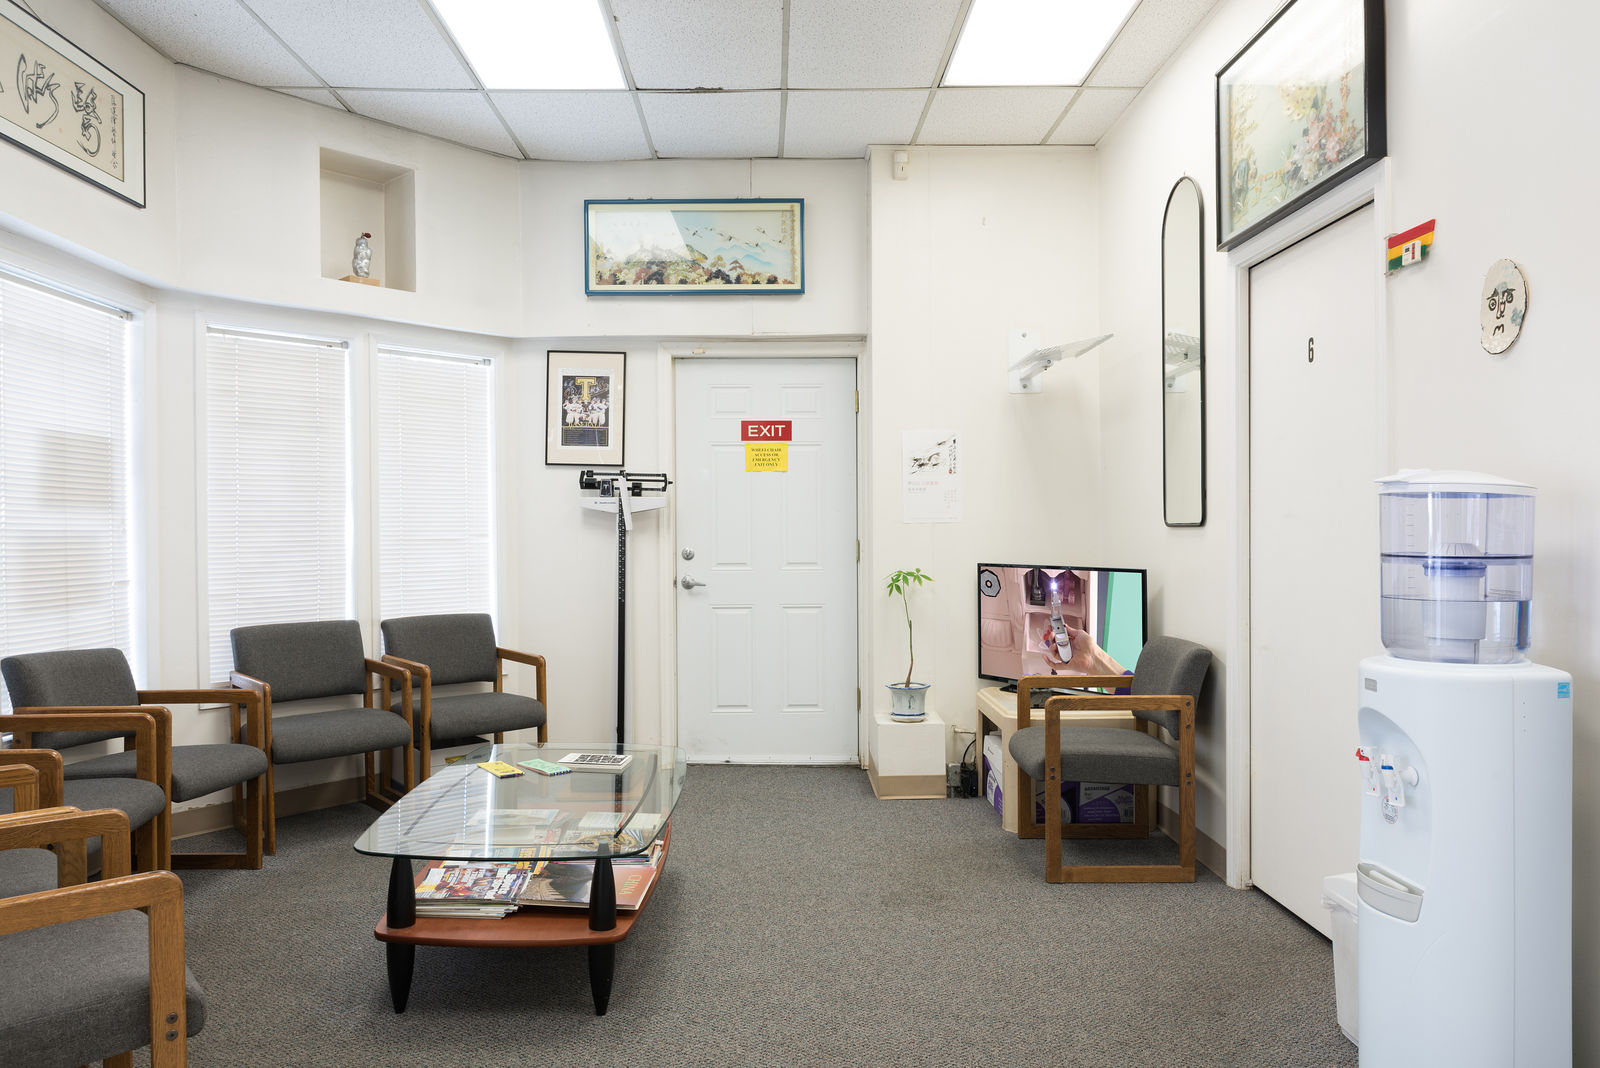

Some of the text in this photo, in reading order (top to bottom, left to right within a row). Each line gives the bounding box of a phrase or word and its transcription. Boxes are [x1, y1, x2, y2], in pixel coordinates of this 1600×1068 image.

[1308, 337, 1314, 363] 6
[575, 377, 597, 402] T
[748, 425, 786, 437] EXIT
[618, 874, 642, 895] CHINA
